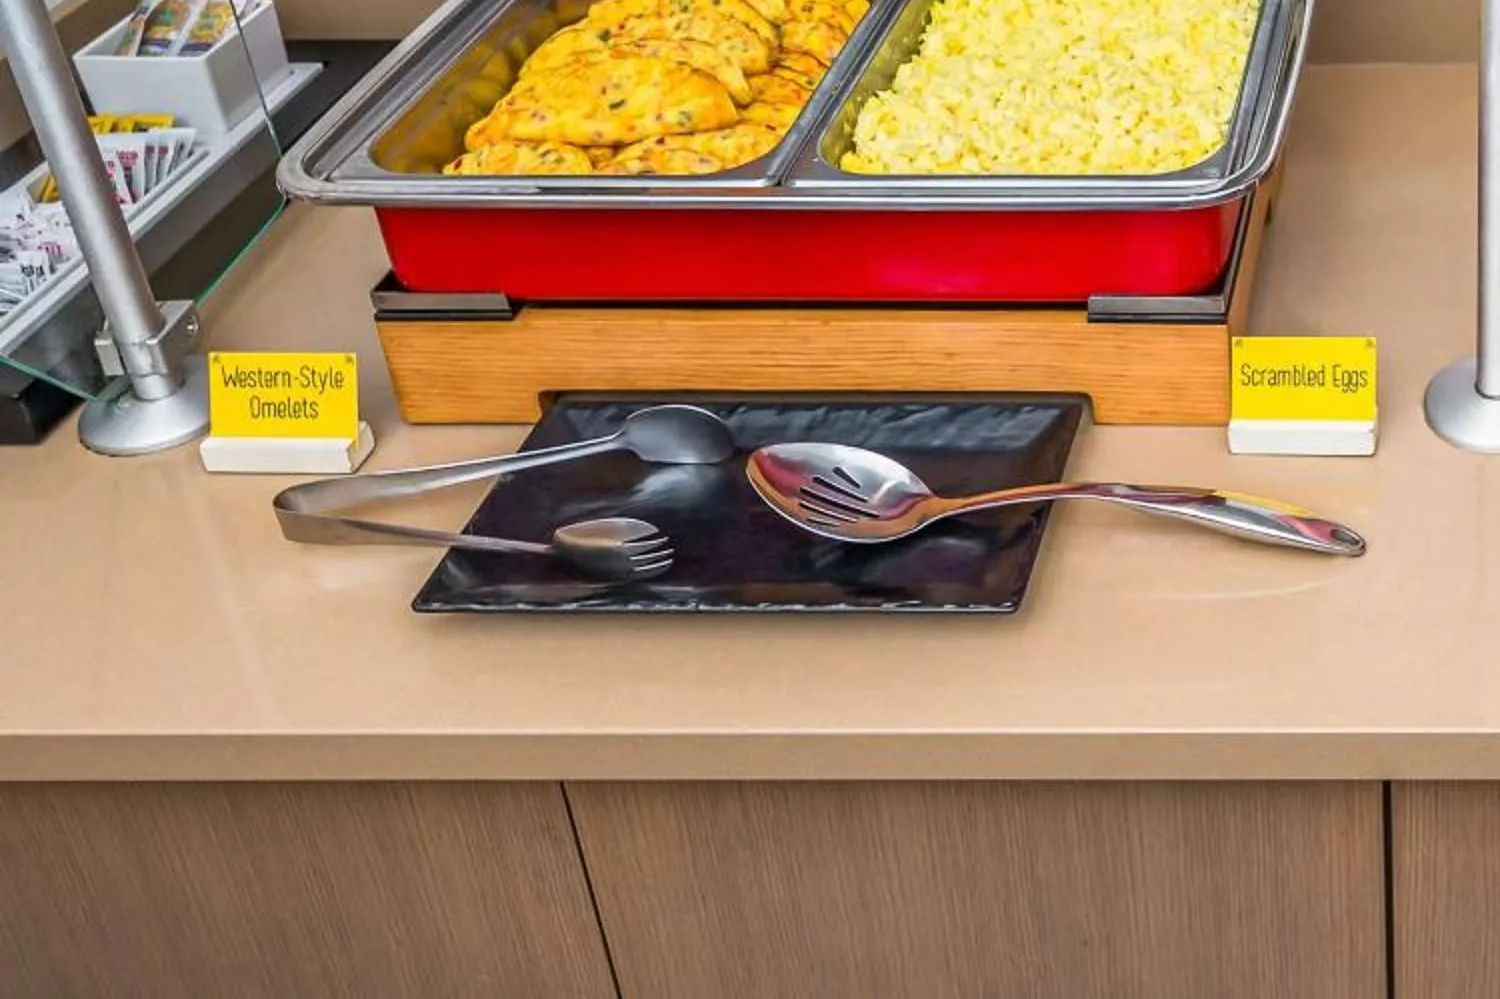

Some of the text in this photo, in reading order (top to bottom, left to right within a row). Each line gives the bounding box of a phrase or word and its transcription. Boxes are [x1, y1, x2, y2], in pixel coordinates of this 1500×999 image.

[221, 364, 345, 395] Western-Style
[1240, 362, 1369, 394] Scrambled Eggs
[249, 394, 320, 420] Omelets
